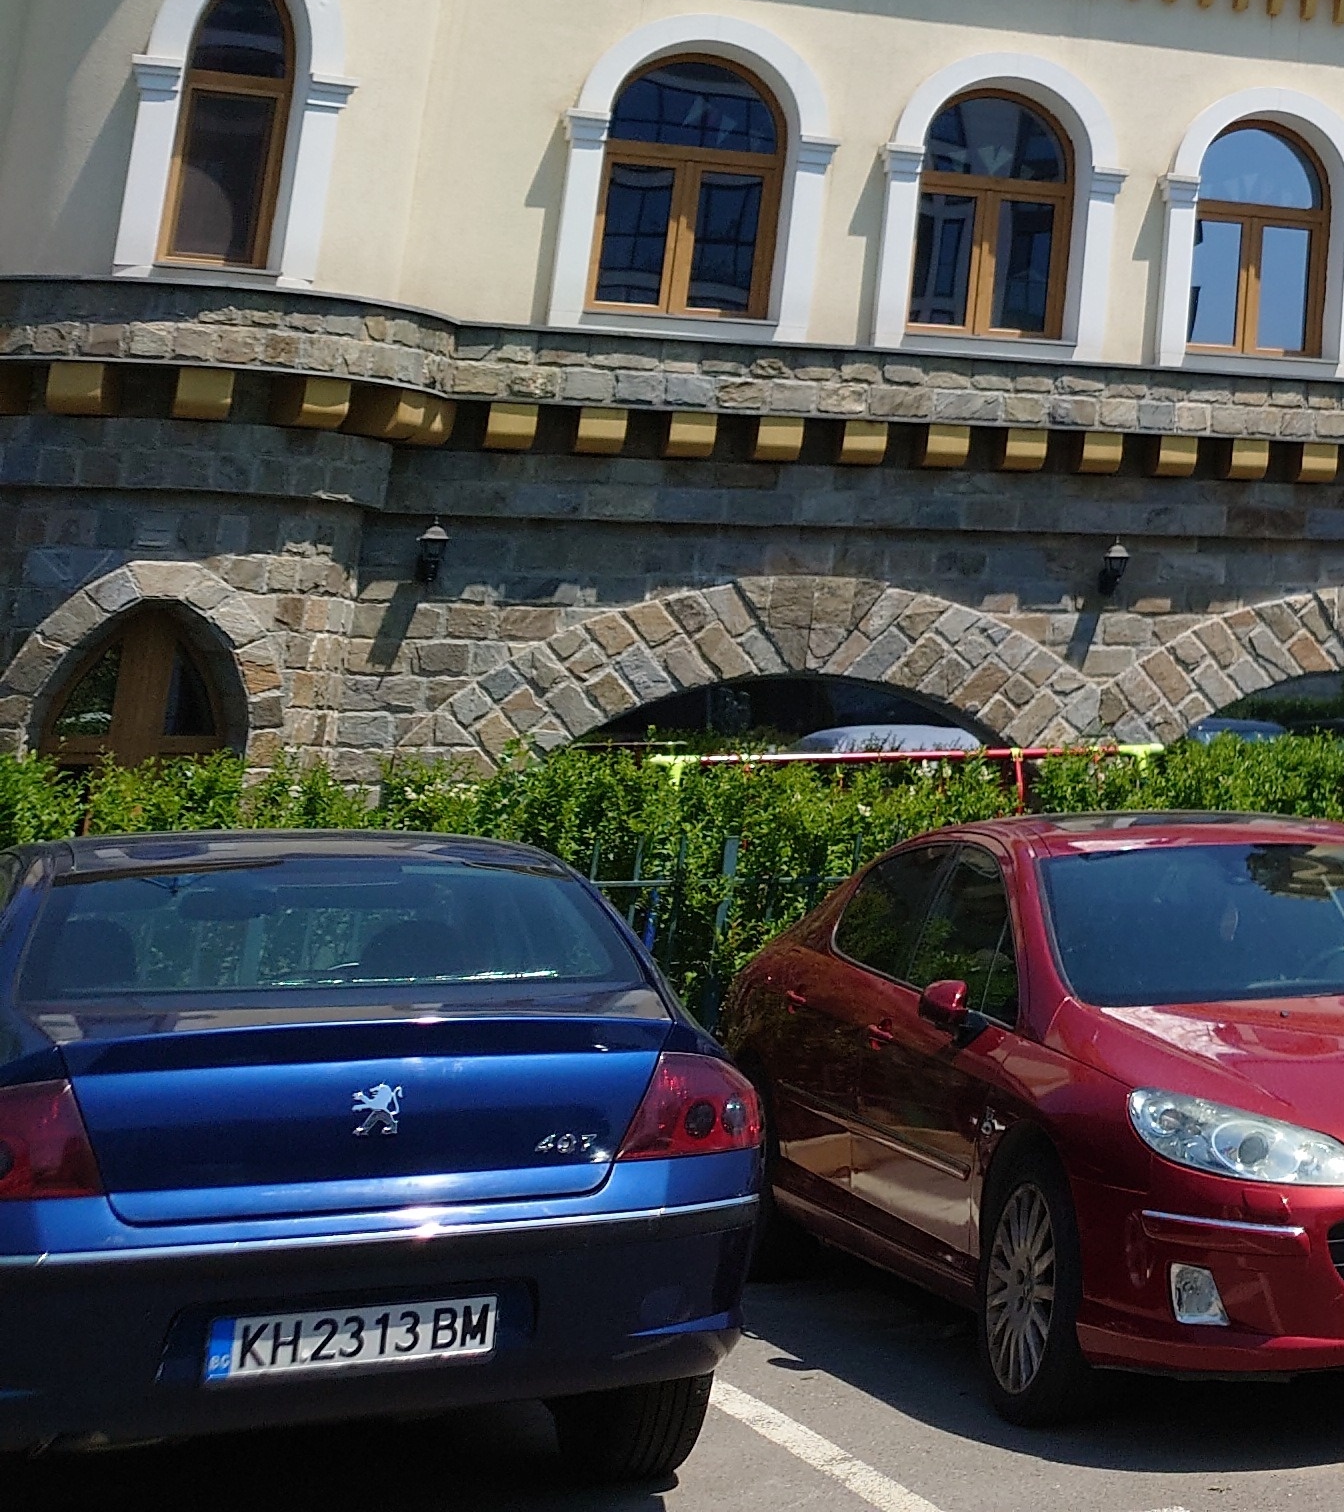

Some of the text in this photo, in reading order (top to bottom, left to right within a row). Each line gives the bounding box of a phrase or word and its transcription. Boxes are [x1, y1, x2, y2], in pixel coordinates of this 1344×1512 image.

[534, 1133, 598, 1154] 407
[310, 1310, 421, 1362] 2313
[430, 1303, 491, 1352] BM
